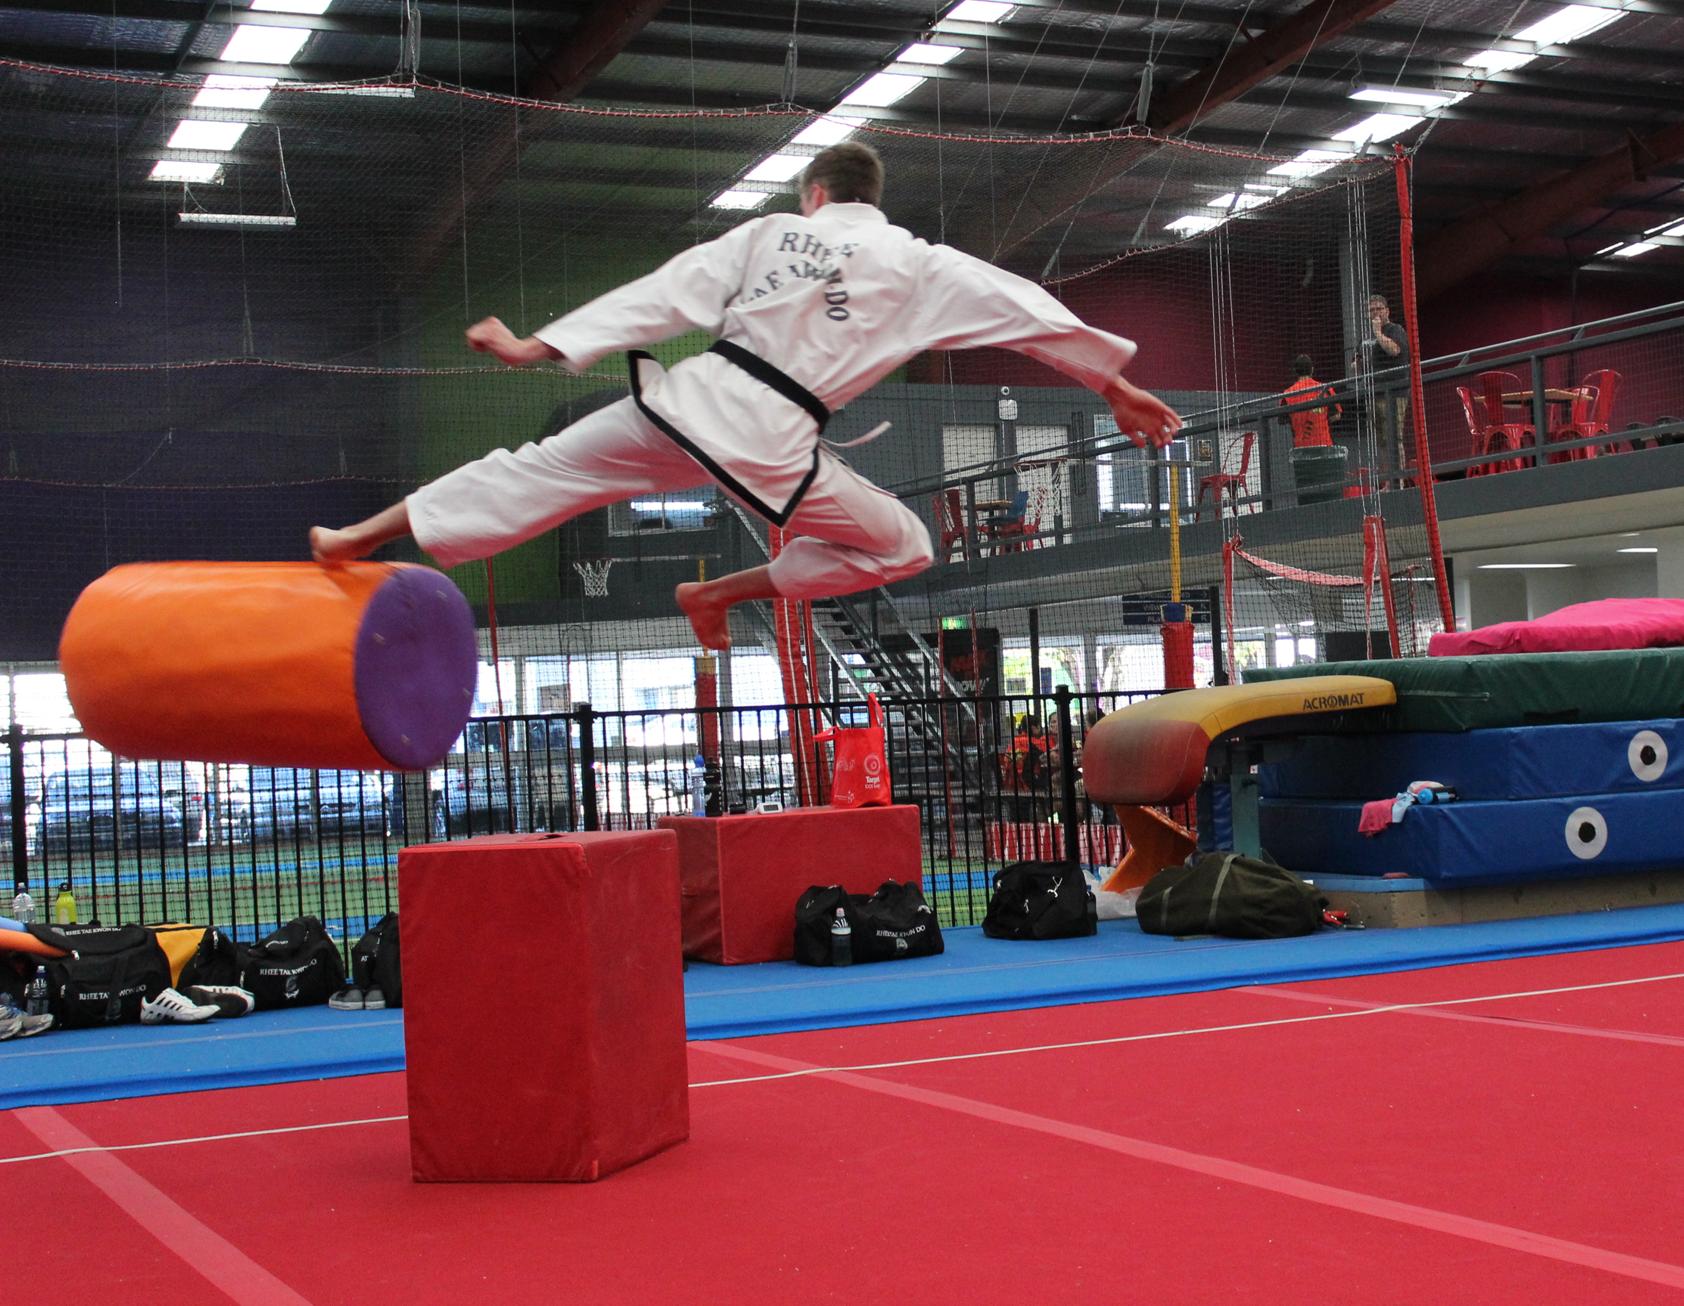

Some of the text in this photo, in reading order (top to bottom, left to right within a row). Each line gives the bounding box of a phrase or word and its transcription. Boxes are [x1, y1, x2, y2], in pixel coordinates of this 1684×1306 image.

[824, 290, 850, 321] DO
[1303, 693, 1365, 711] ACROMAT
[916, 924, 926, 933] DO
